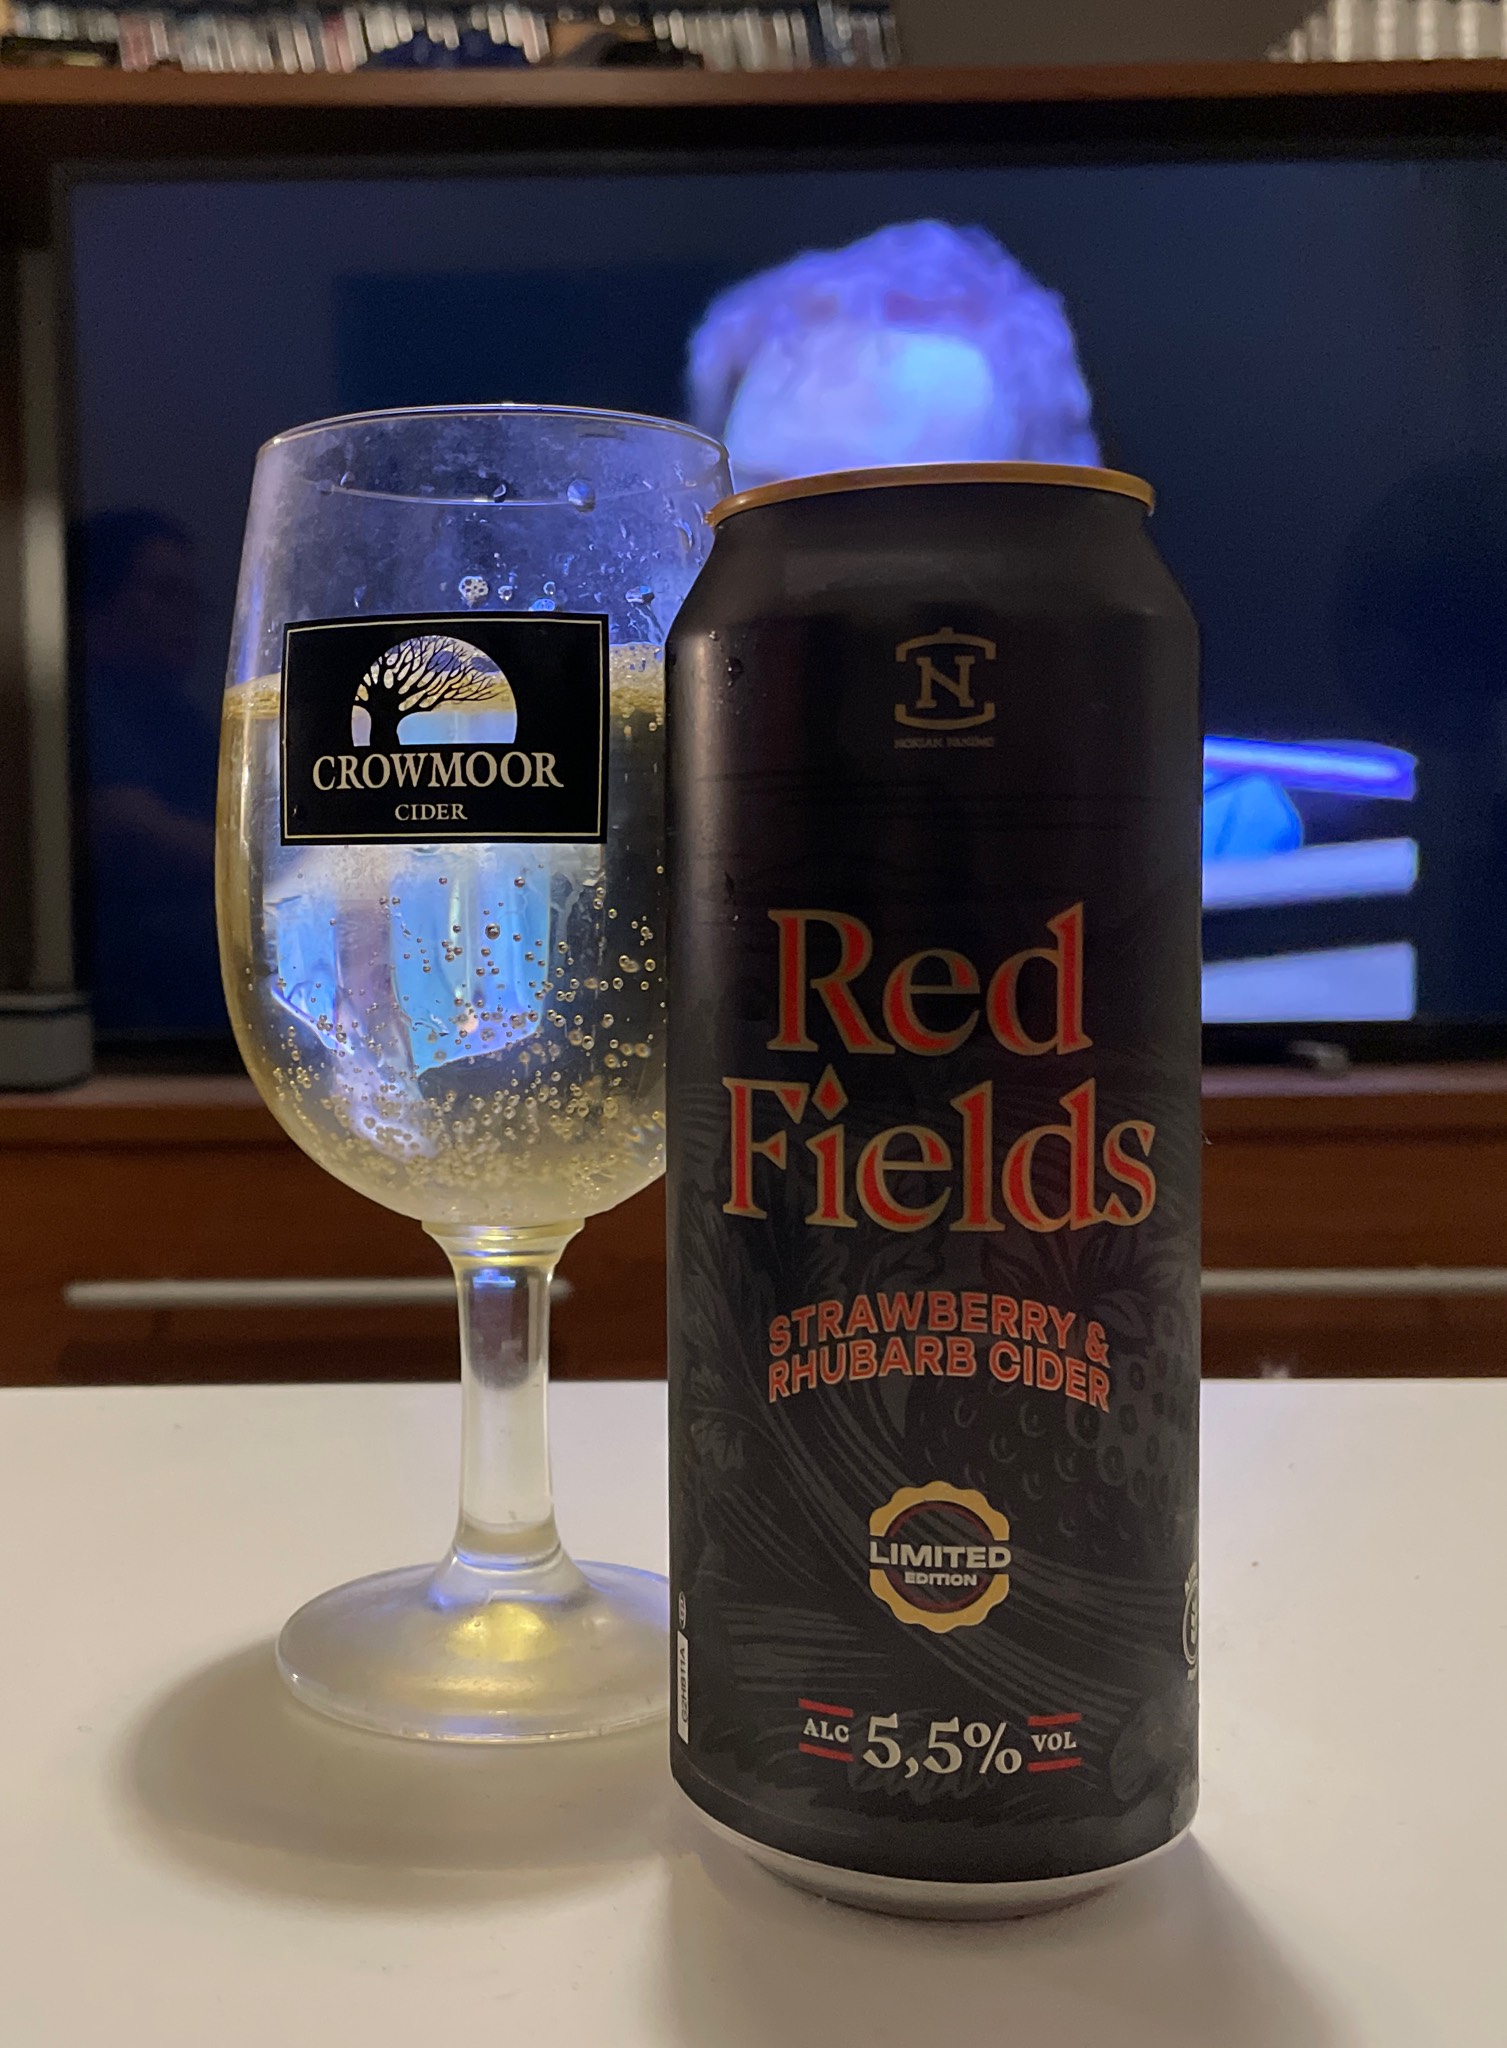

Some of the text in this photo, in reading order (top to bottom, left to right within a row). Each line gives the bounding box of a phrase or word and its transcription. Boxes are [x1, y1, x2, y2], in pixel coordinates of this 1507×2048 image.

[914, 655, 976, 709] N
[312, 750, 565, 791] CROWMOOR
[394, 802, 468, 821] CIDER
[766, 901, 1094, 1057] Red
[722, 1063, 1157, 1234] Fields
[768, 1290, 1112, 1369] STRAWBERRY &
[768, 1336, 1111, 1414] RHUBARB CIDER
[869, 1541, 1012, 1569] LIMITED
[904, 1571, 978, 1587] EDITION
[802, 1712, 1077, 1779] ALC 5,5% VOL
